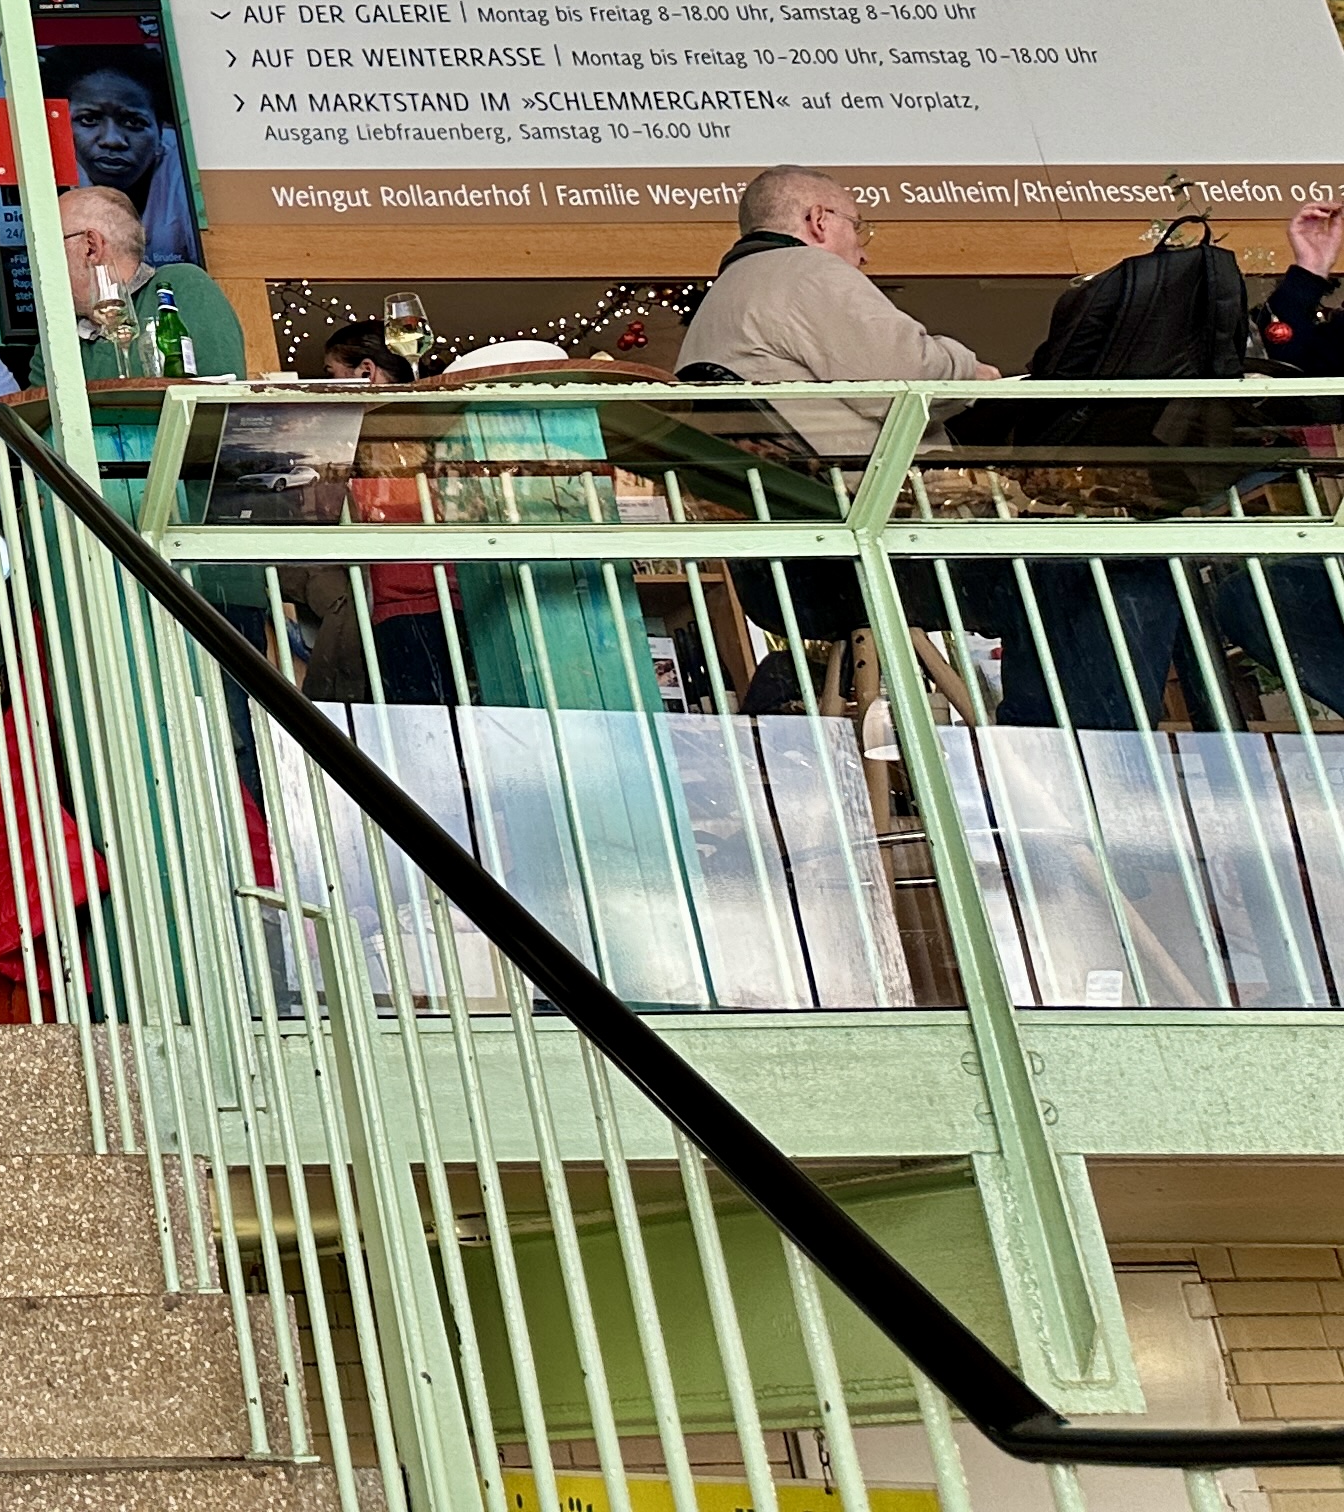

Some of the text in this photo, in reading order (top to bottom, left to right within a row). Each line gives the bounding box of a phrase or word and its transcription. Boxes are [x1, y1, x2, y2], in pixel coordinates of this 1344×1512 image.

[243, 2, 977, 27] AUF DER GALERIE Montag bis Freitag 8–18.00 Uhr, Samstag 8–16.00 Uhr
[251, 46, 1098, 71] AUF DER WEINTERRASSE Montag bis Freitag 10–20.00 Uhr, Samstag 10–18.00 Uhr
[256, 89, 980, 114] AM MARKTSTAND IM »SCHLEMMERGARTEN« auf dem Vorplatz,
[264, 120, 731, 146] Ausgang Liebfrauenberg, Samstag 10–16.00 Uhr
[271, 185, 372, 212] Weingut
[379, 183, 531, 207] Rollanderhof
[555, 182, 641, 206] Familie
[646, 181, 746, 210] Weyerhä
[843, 185, 891, 208] 291
[899, 178, 1176, 208] Saulheim/Rheinhessen
[1195, 178, 1283, 202] Telefon
[5, 227, 25, 239] 24/
